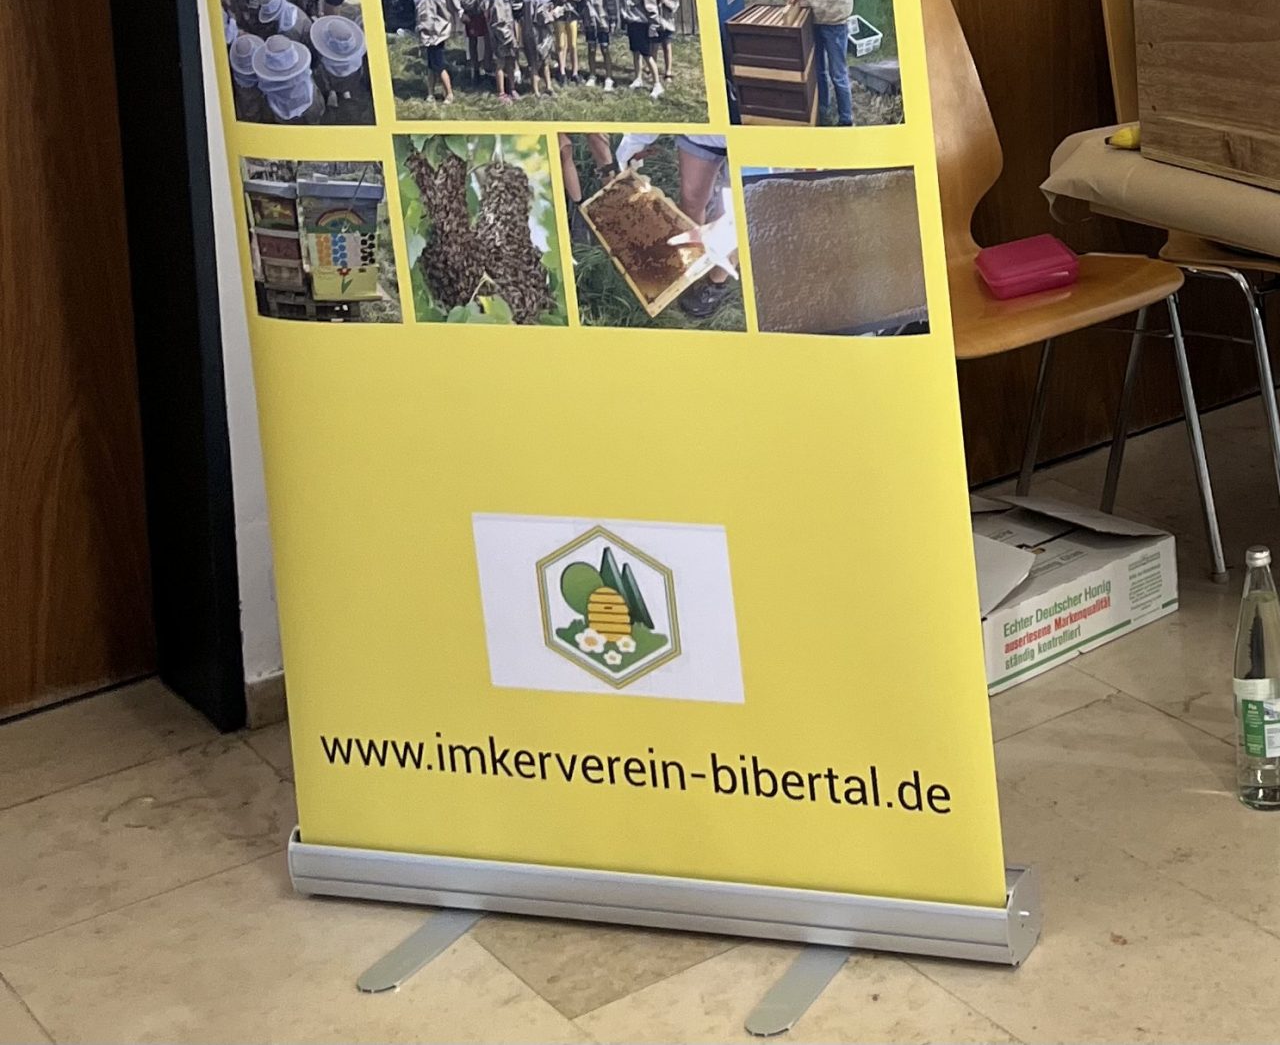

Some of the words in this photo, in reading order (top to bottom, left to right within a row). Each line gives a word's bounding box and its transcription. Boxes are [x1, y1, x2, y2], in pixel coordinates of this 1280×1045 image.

[1003, 613, 1034, 638] Echter
[1035, 590, 1083, 624] Deutscher
[1084, 579, 1112, 602] Honig
[1004, 623, 1052, 654] auserlesene
[1054, 595, 1112, 631] Markenqualität
[1005, 649, 1036, 671] ständig
[1037, 624, 1082, 655] kontrolliert
[320, 732, 952, 814] www.imkerverein-bibertal.de
